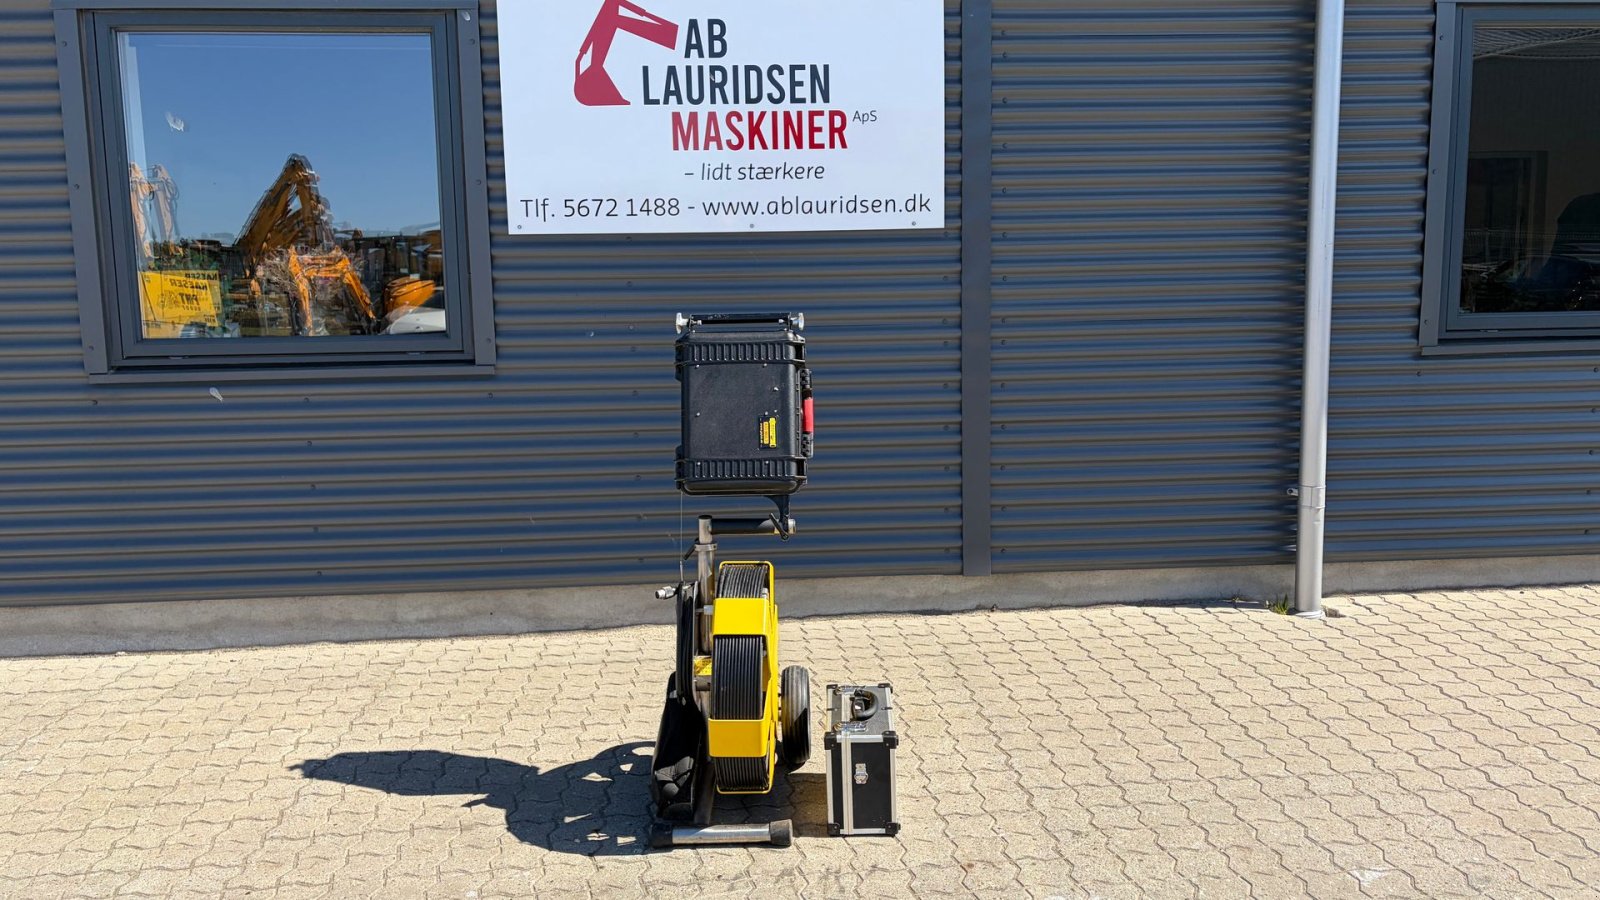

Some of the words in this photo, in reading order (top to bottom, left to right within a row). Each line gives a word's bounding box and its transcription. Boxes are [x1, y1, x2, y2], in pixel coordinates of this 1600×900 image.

[684, 18, 728, 59] AB
[642, 63, 831, 106] LAURIDSEN
[671, 109, 848, 151] MASKINER
[852, 109, 878, 125] ApS
[701, 162, 733, 181] lidt
[736, 164, 825, 181] stærkere
[520, 197, 555, 223] Tlf.
[563, 198, 619, 218] 5672
[626, 198, 680, 217] 1488
[701, 193, 932, 216] www.ablauridsen.dk
